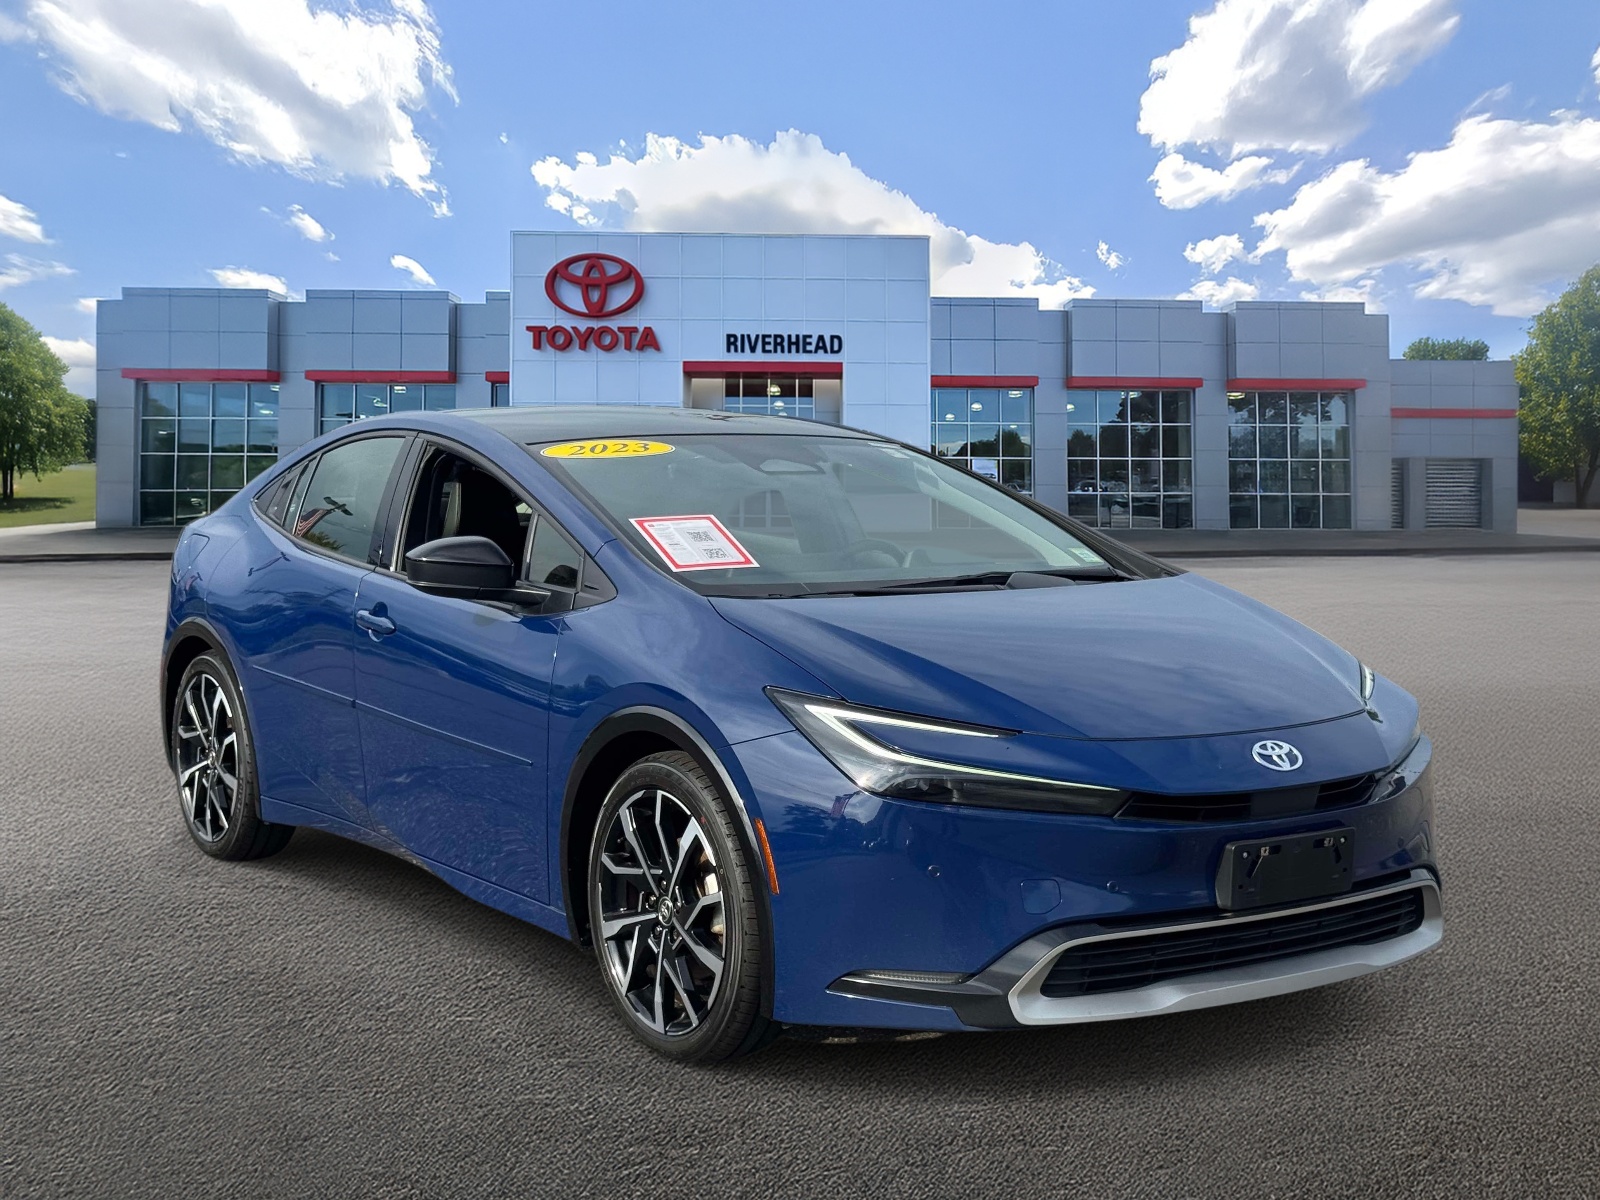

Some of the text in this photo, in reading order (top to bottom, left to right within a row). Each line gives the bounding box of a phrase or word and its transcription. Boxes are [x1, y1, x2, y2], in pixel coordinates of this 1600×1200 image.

[526, 325, 661, 352] TOYOTA
[726, 333, 843, 354] RIVERHEAD
[568, 443, 650, 456] 2023
